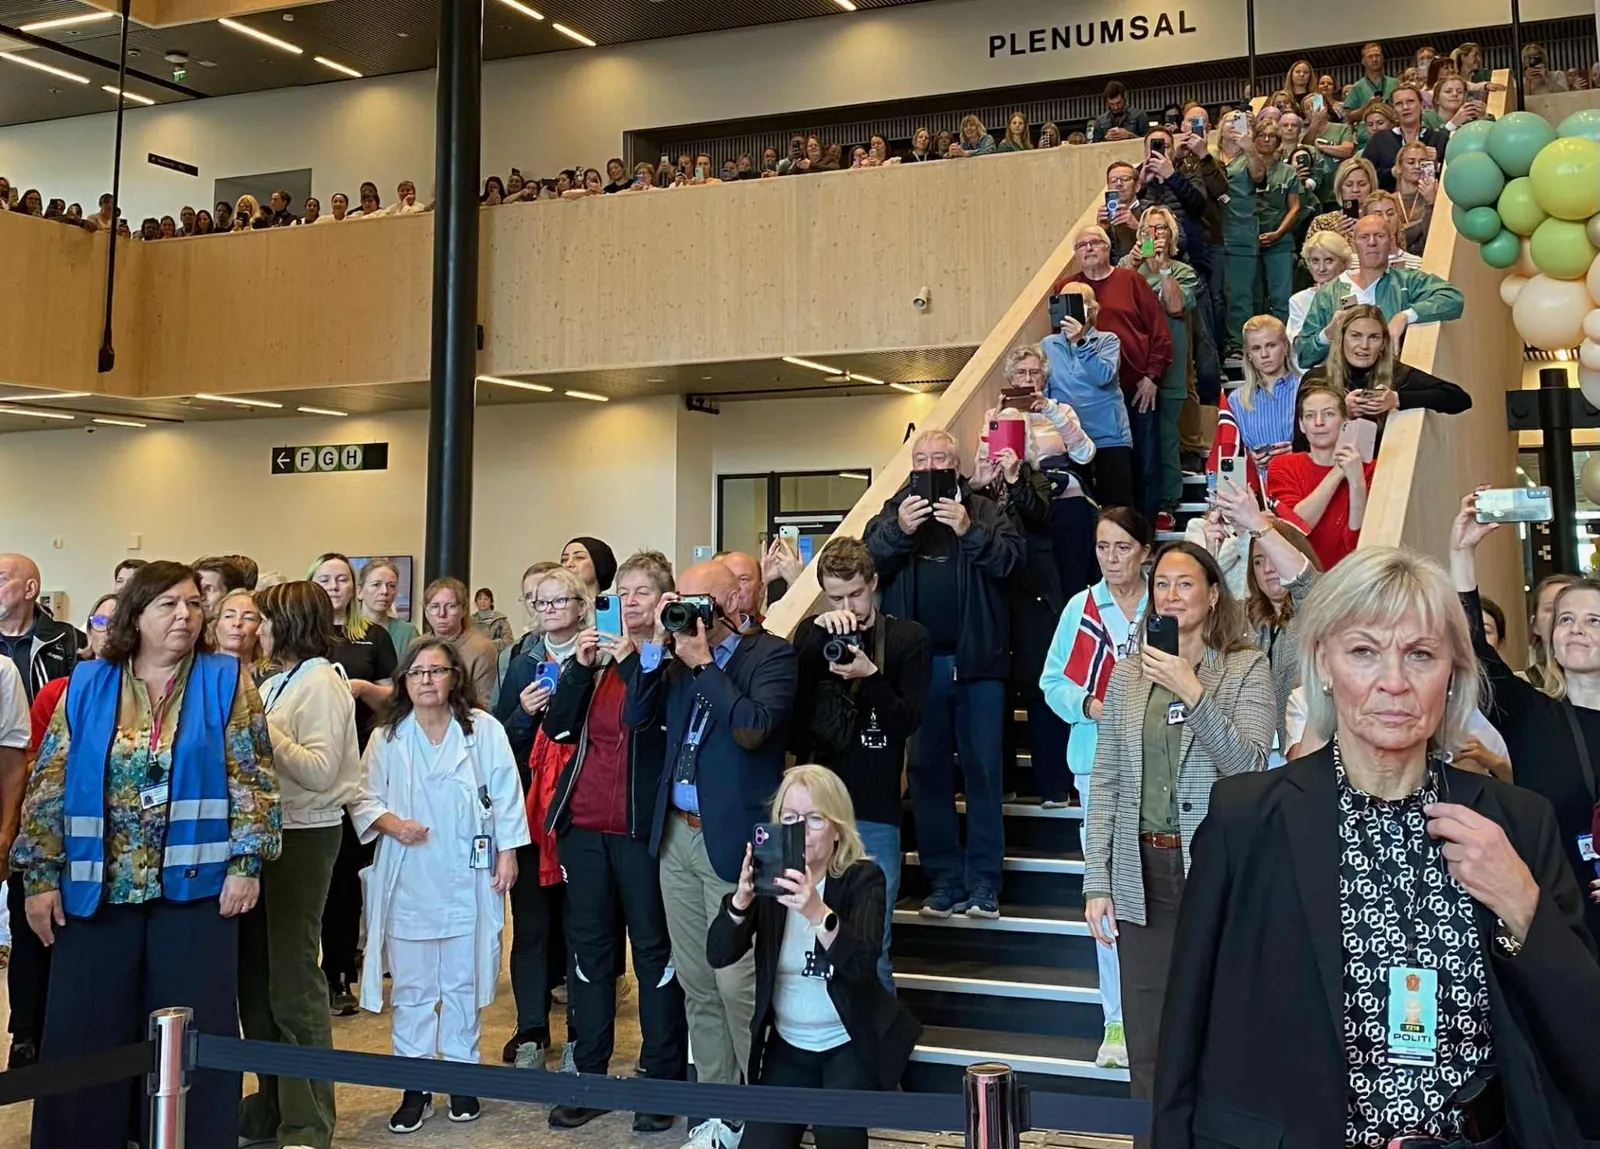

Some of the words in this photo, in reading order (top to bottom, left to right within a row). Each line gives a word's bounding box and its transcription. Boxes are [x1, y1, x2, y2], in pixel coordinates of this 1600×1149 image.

[989, 10, 1197, 58] PLENUMSAL
[300, 452, 310, 467] F
[323, 451, 334, 466] G
[346, 450, 357, 465] H
[1393, 1033, 1431, 1043] POLITI
